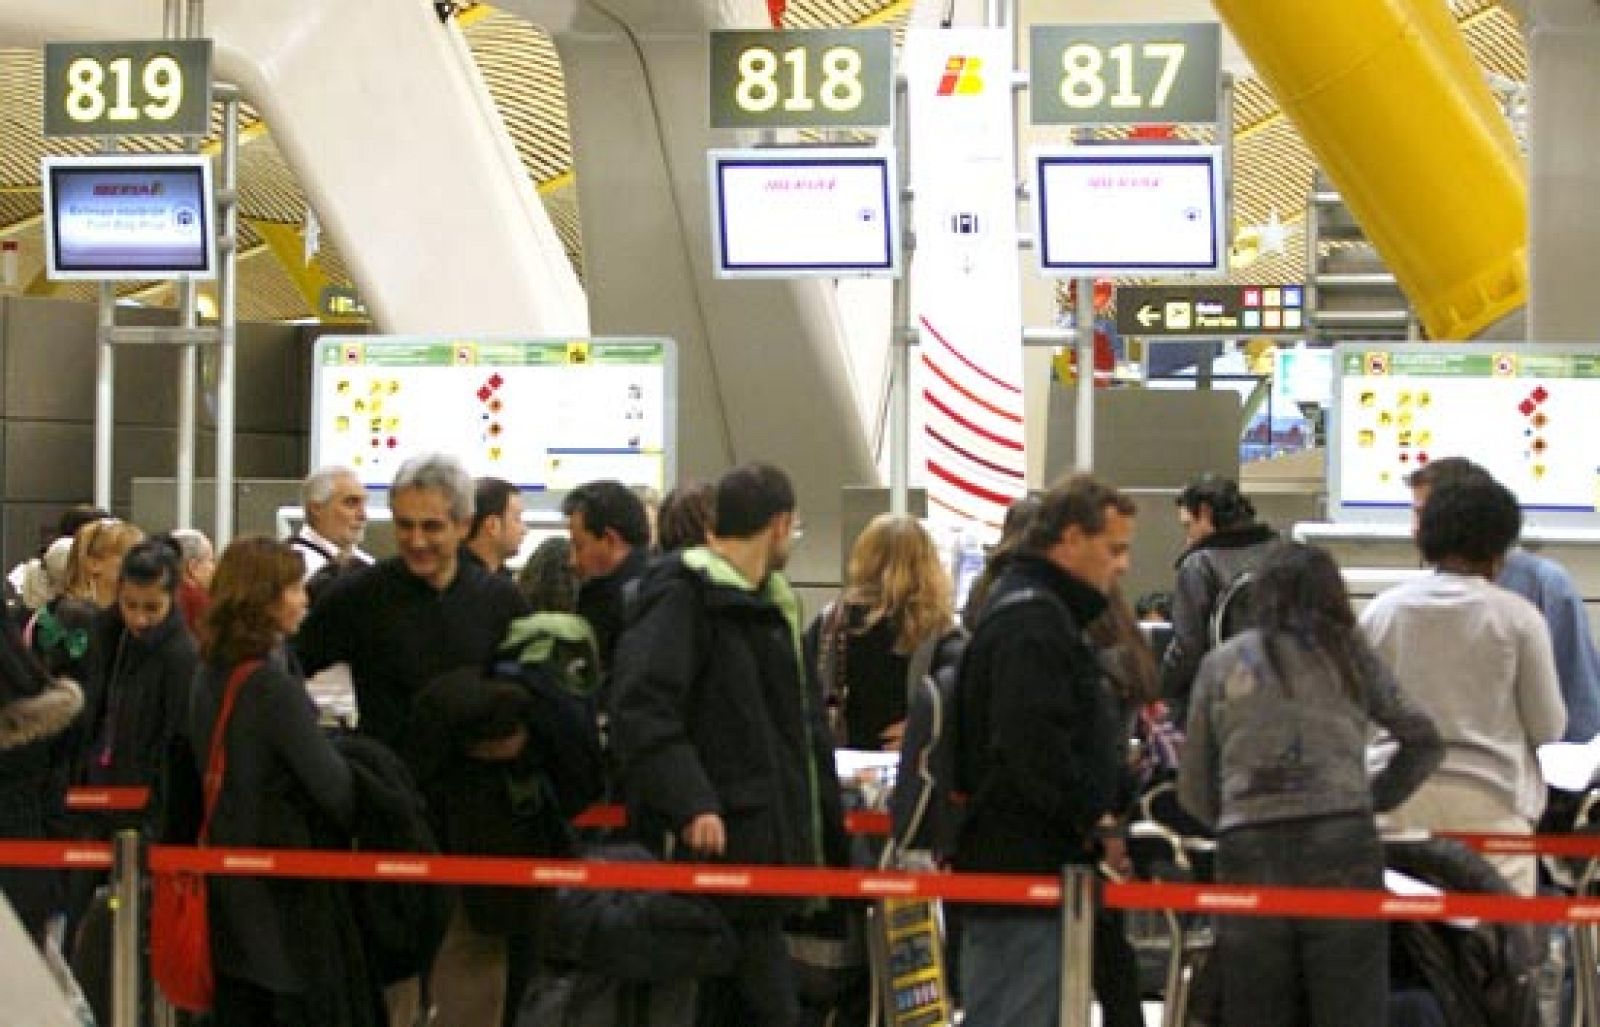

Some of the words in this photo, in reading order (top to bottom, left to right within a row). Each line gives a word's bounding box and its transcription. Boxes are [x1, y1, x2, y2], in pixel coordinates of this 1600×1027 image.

[66, 56, 184, 122] 819
[735, 46, 863, 111] 818
[1059, 43, 1187, 107] 817
